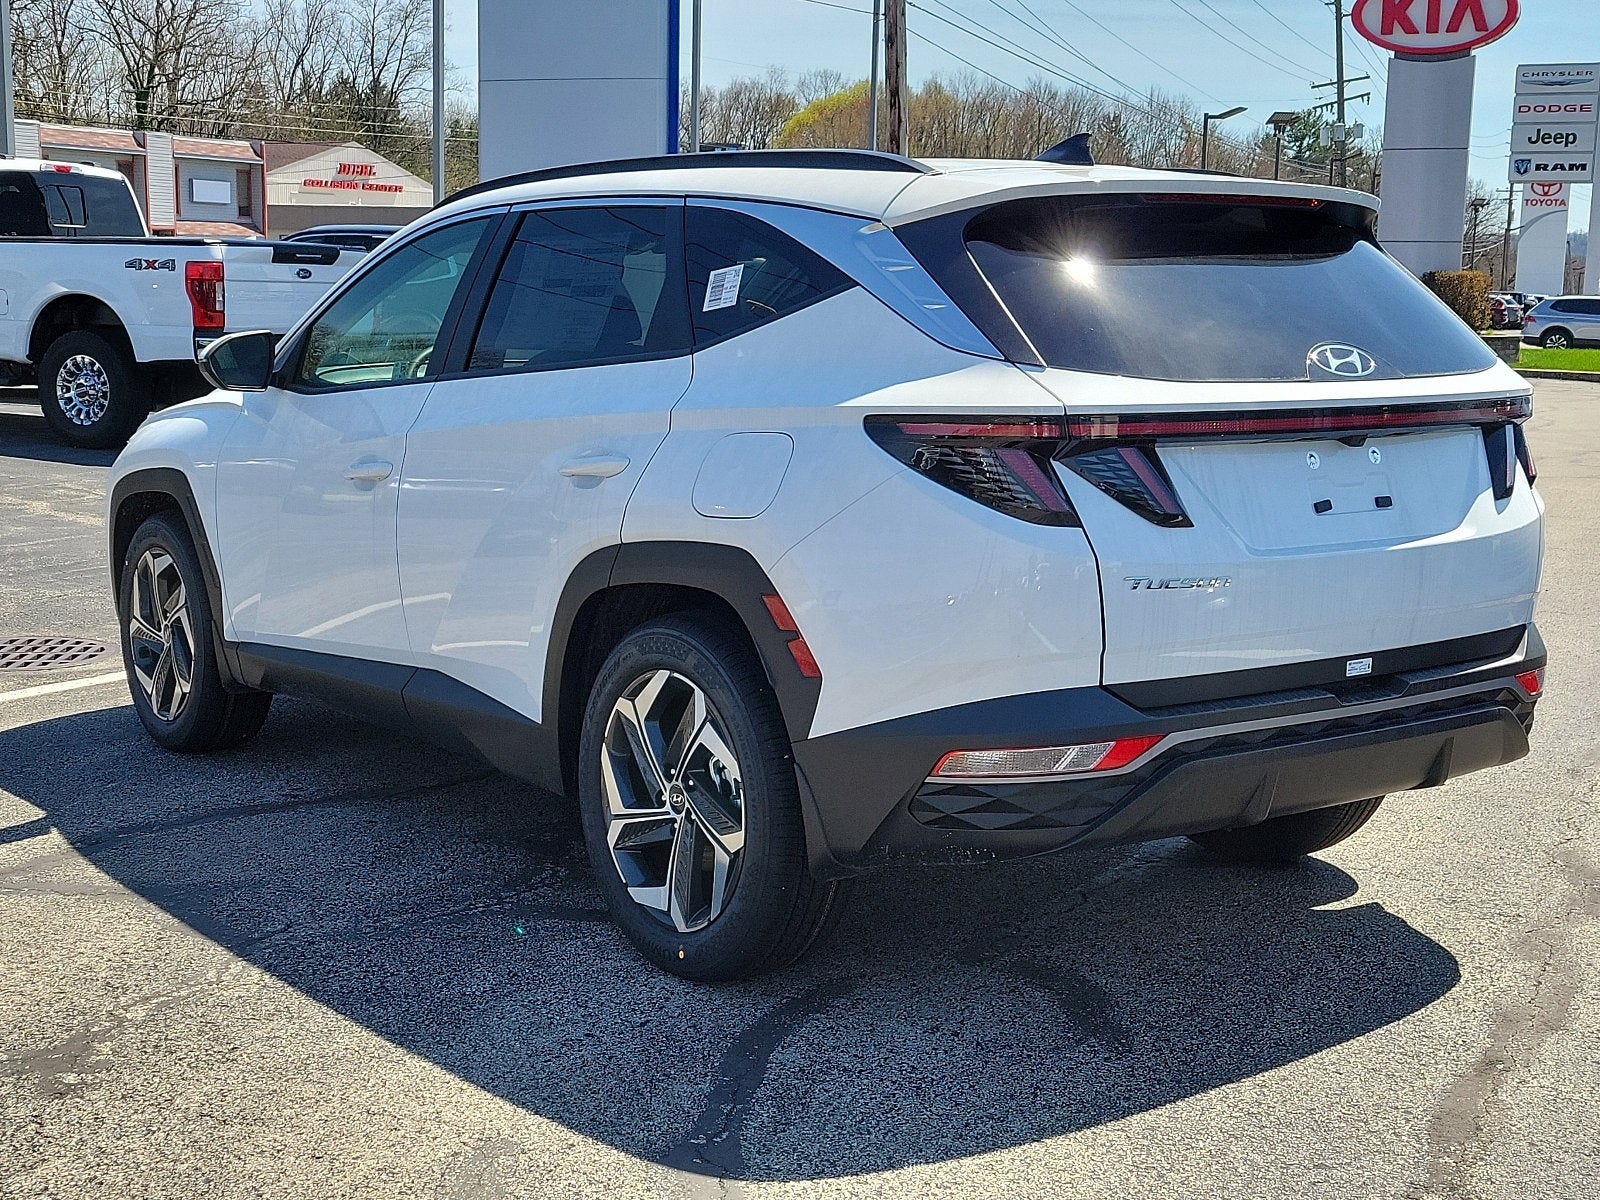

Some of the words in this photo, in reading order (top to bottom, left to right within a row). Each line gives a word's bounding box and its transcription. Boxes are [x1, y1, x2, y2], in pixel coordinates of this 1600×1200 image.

[1380, 0, 1489, 35] KIA
[1521, 70, 1593, 78] CHRYSLER
[1518, 104, 1593, 113] DODGE
[1527, 128, 1578, 148] Jeep
[1534, 163, 1588, 172] RAM
[1524, 198, 1567, 207] TOYOTA
